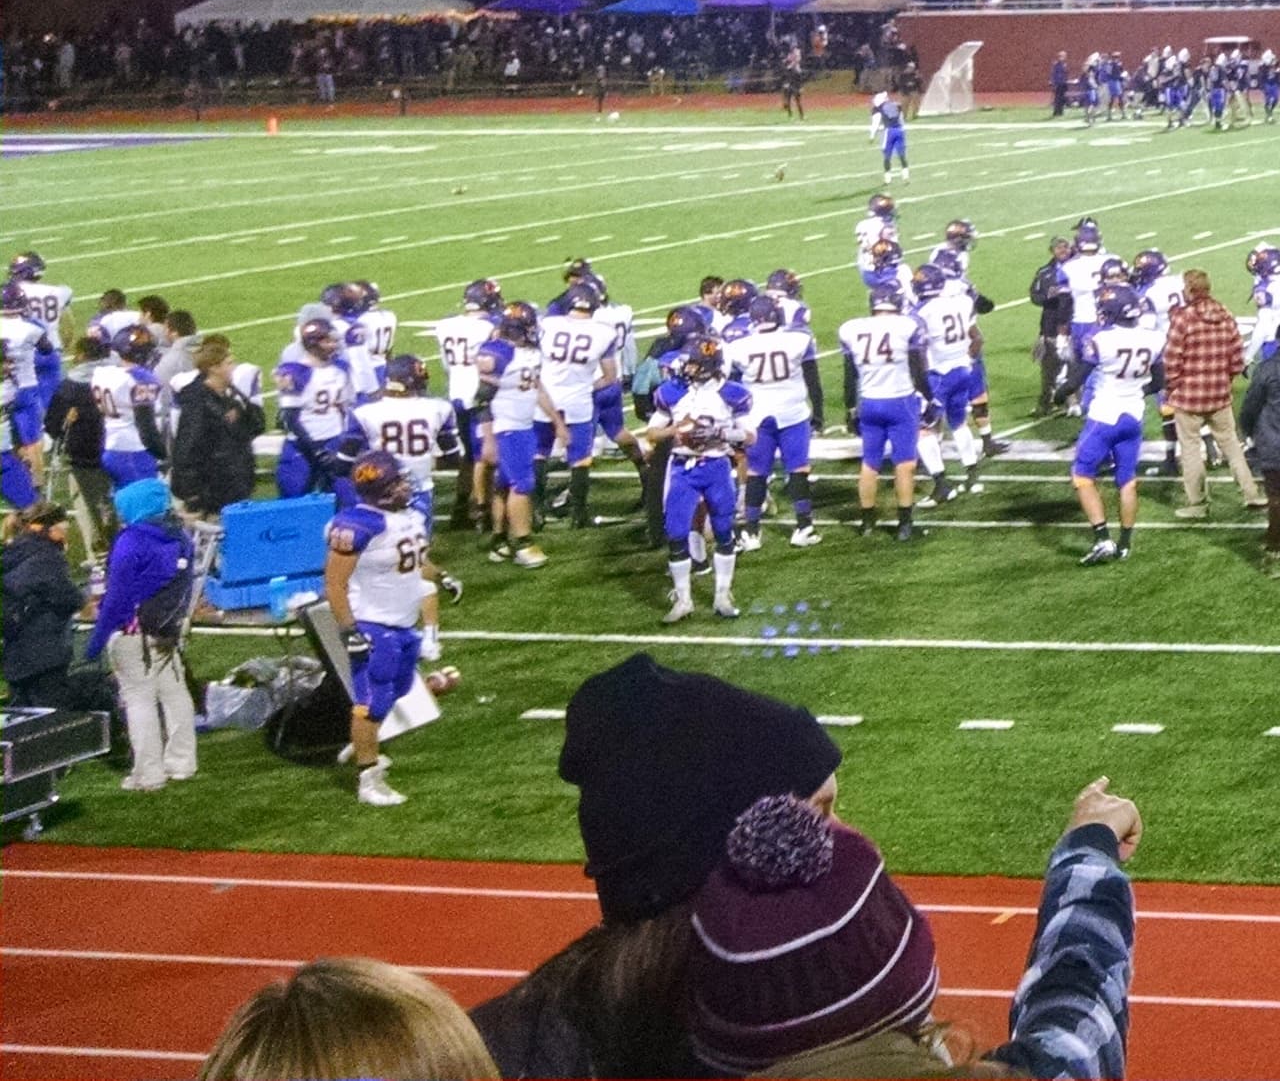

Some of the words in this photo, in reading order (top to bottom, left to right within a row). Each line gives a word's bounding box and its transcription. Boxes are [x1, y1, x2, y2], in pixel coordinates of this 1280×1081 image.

[375, 326, 393, 356] 17
[943, 312, 965, 345] 21
[443, 336, 471, 366] 67
[551, 331, 593, 365] 92
[857, 332, 893, 365] 74
[1115, 347, 1152, 379] 73
[748, 350, 790, 384] 70
[381, 419, 431, 457] 86
